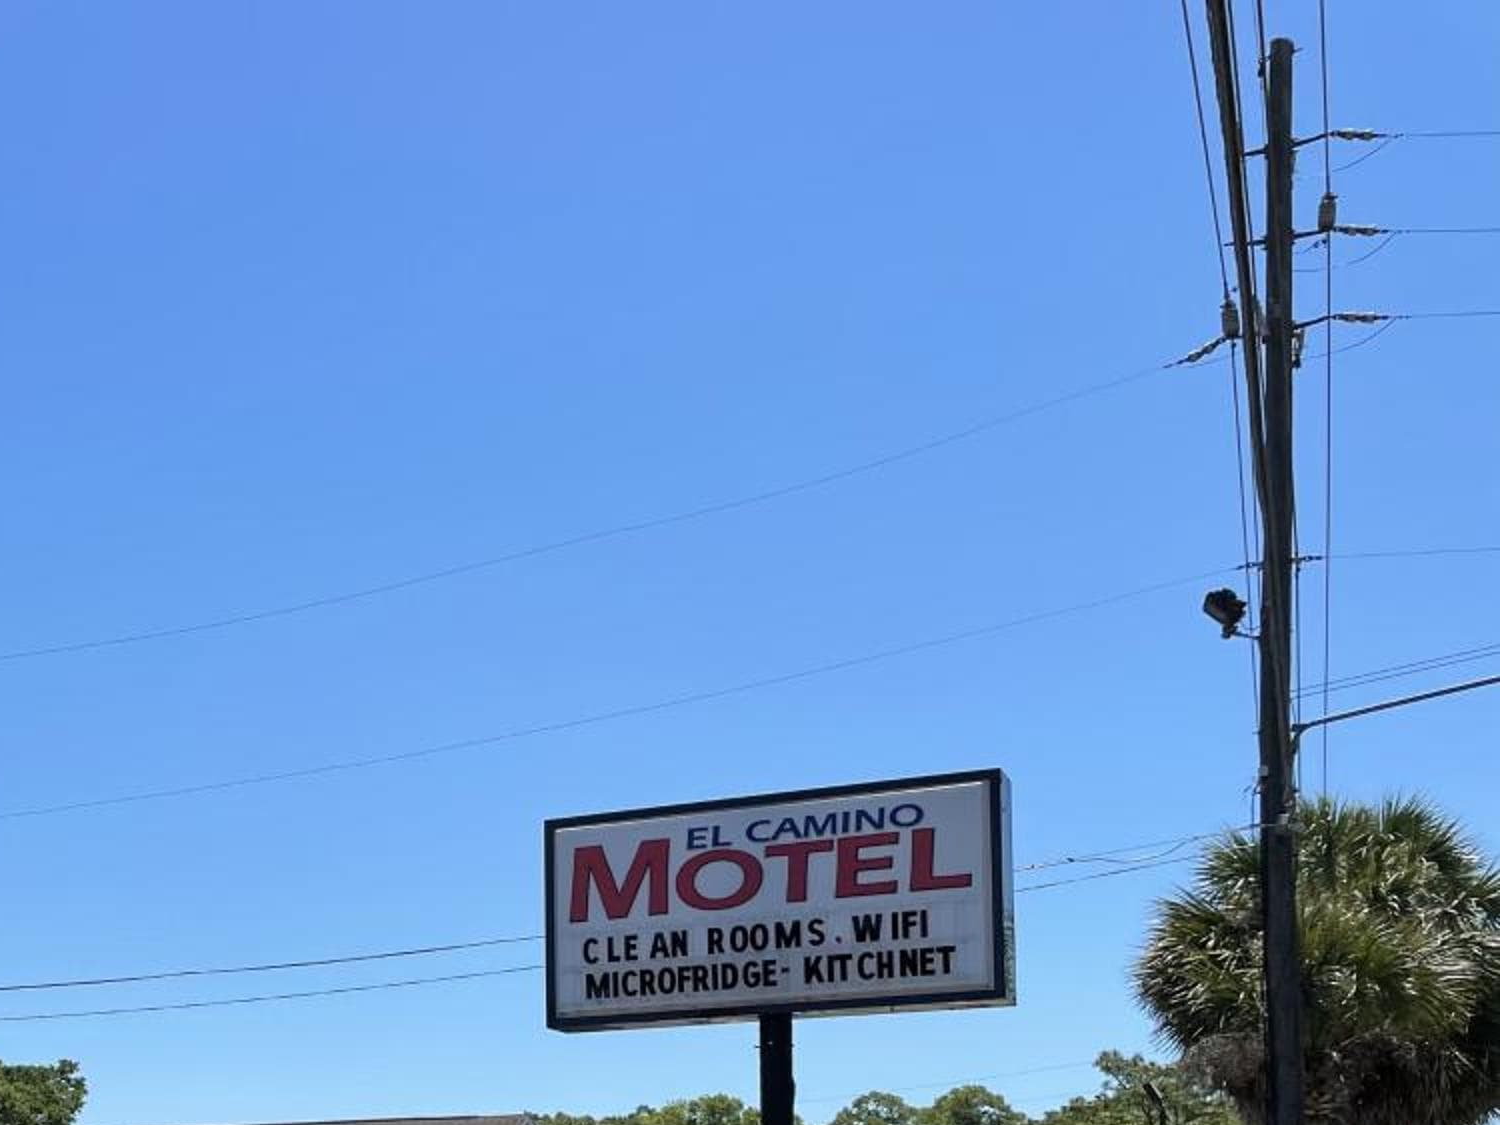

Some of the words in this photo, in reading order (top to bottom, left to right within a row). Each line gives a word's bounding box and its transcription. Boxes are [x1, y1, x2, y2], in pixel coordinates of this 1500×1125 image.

[686, 826, 732, 850] EL
[745, 803, 924, 842] CAMINO
[569, 827, 973, 923] MOTEL
[583, 929, 688, 964] CLEAN
[852, 909, 929, 944] WIFI
[803, 945, 956, 985] KITCHNET
